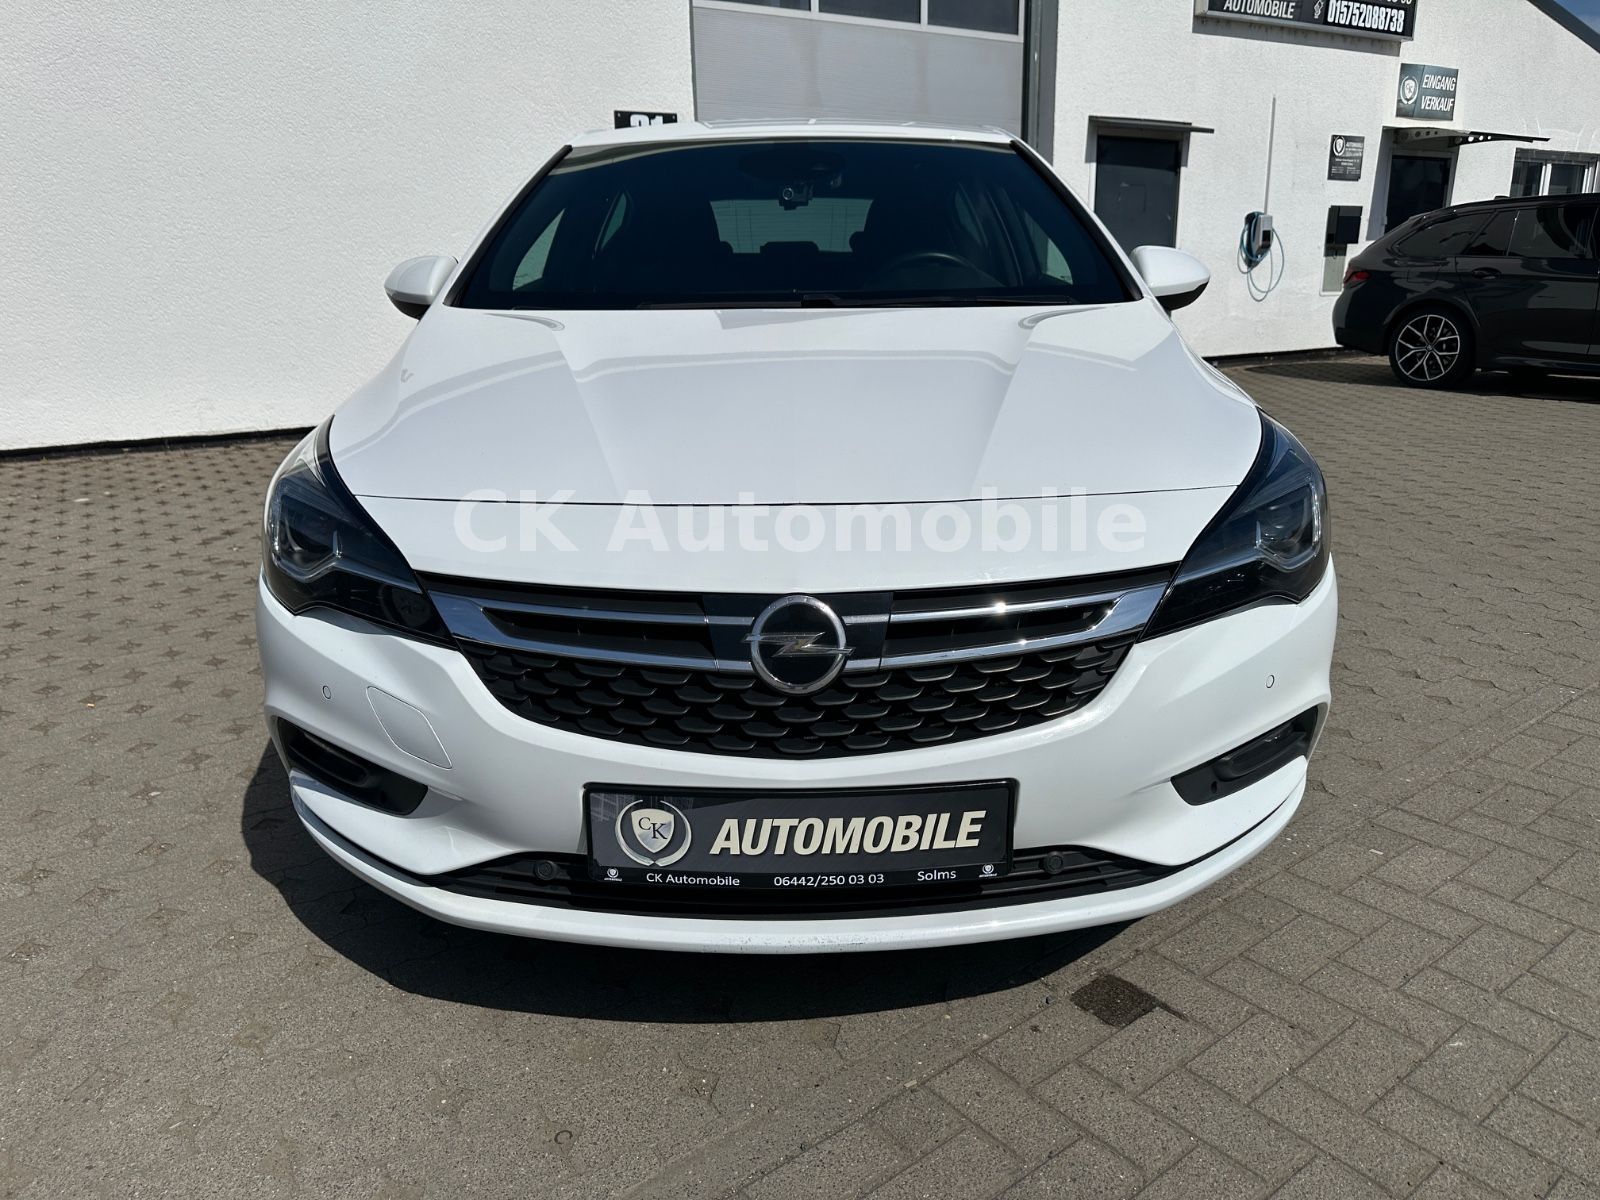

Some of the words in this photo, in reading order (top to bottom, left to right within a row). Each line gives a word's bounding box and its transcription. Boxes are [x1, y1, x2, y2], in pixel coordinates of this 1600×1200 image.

[1223, 0, 1296, 19] AUTOMOBILE
[1327, 0, 1405, 33] 015752088738
[1422, 74, 1457, 91] EINGANG
[1421, 95, 1455, 112] VERKAUF
[709, 810, 987, 856] AUTOMOBILE
[646, 873, 663, 883] CK
[665, 874, 740, 886] Automobile
[773, 875, 846, 887] 06442/250
[848, 875, 865, 885] 03
[868, 874, 885, 885] 03
[917, 869, 957, 882] Solms
